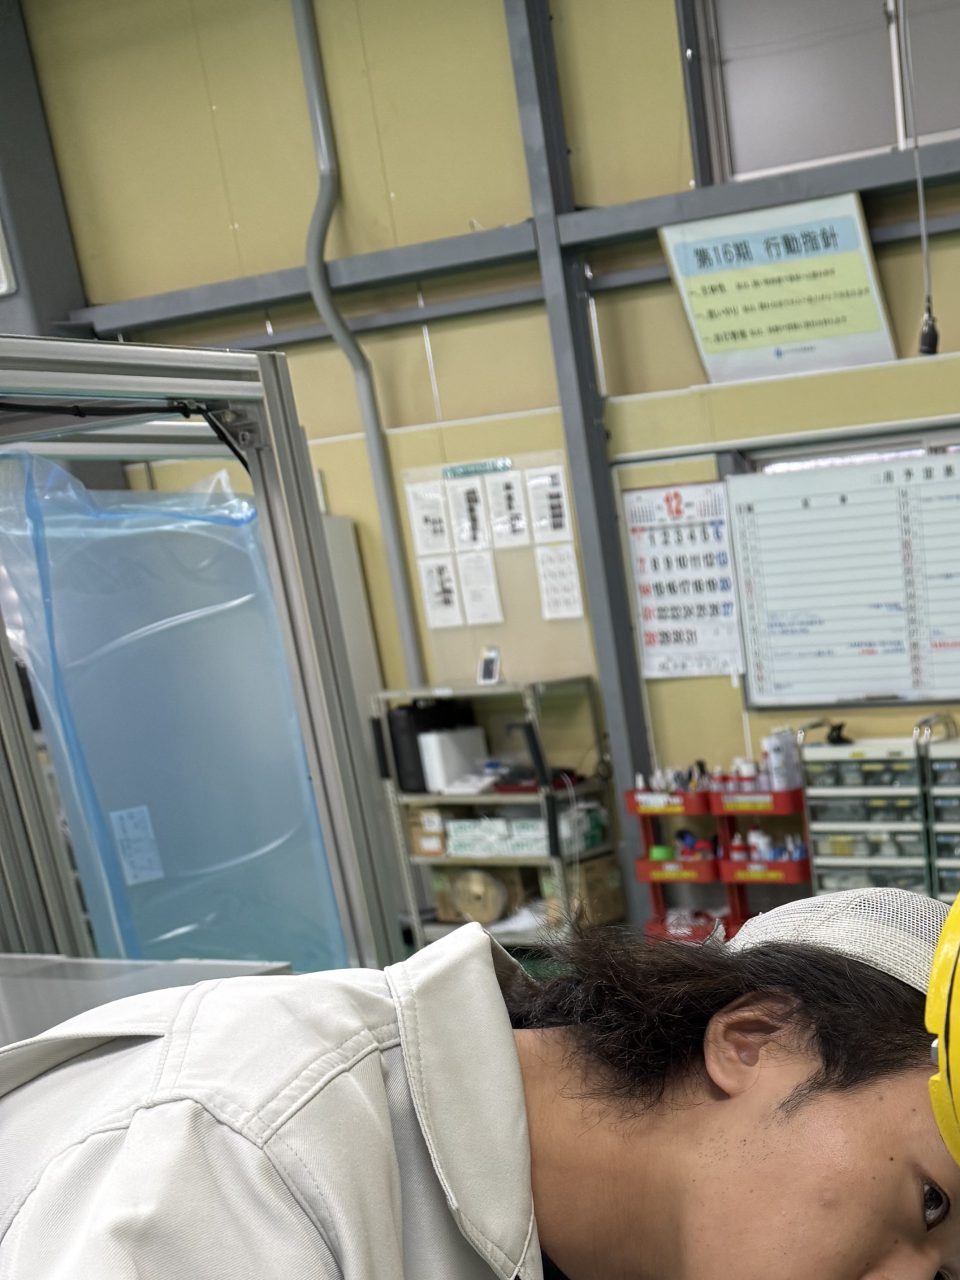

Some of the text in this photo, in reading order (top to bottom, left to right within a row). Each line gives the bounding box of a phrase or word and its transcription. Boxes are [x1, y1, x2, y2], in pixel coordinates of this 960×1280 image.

[694, 225, 838, 269] 第16期 行動指針
[663, 491, 684, 518] 12
